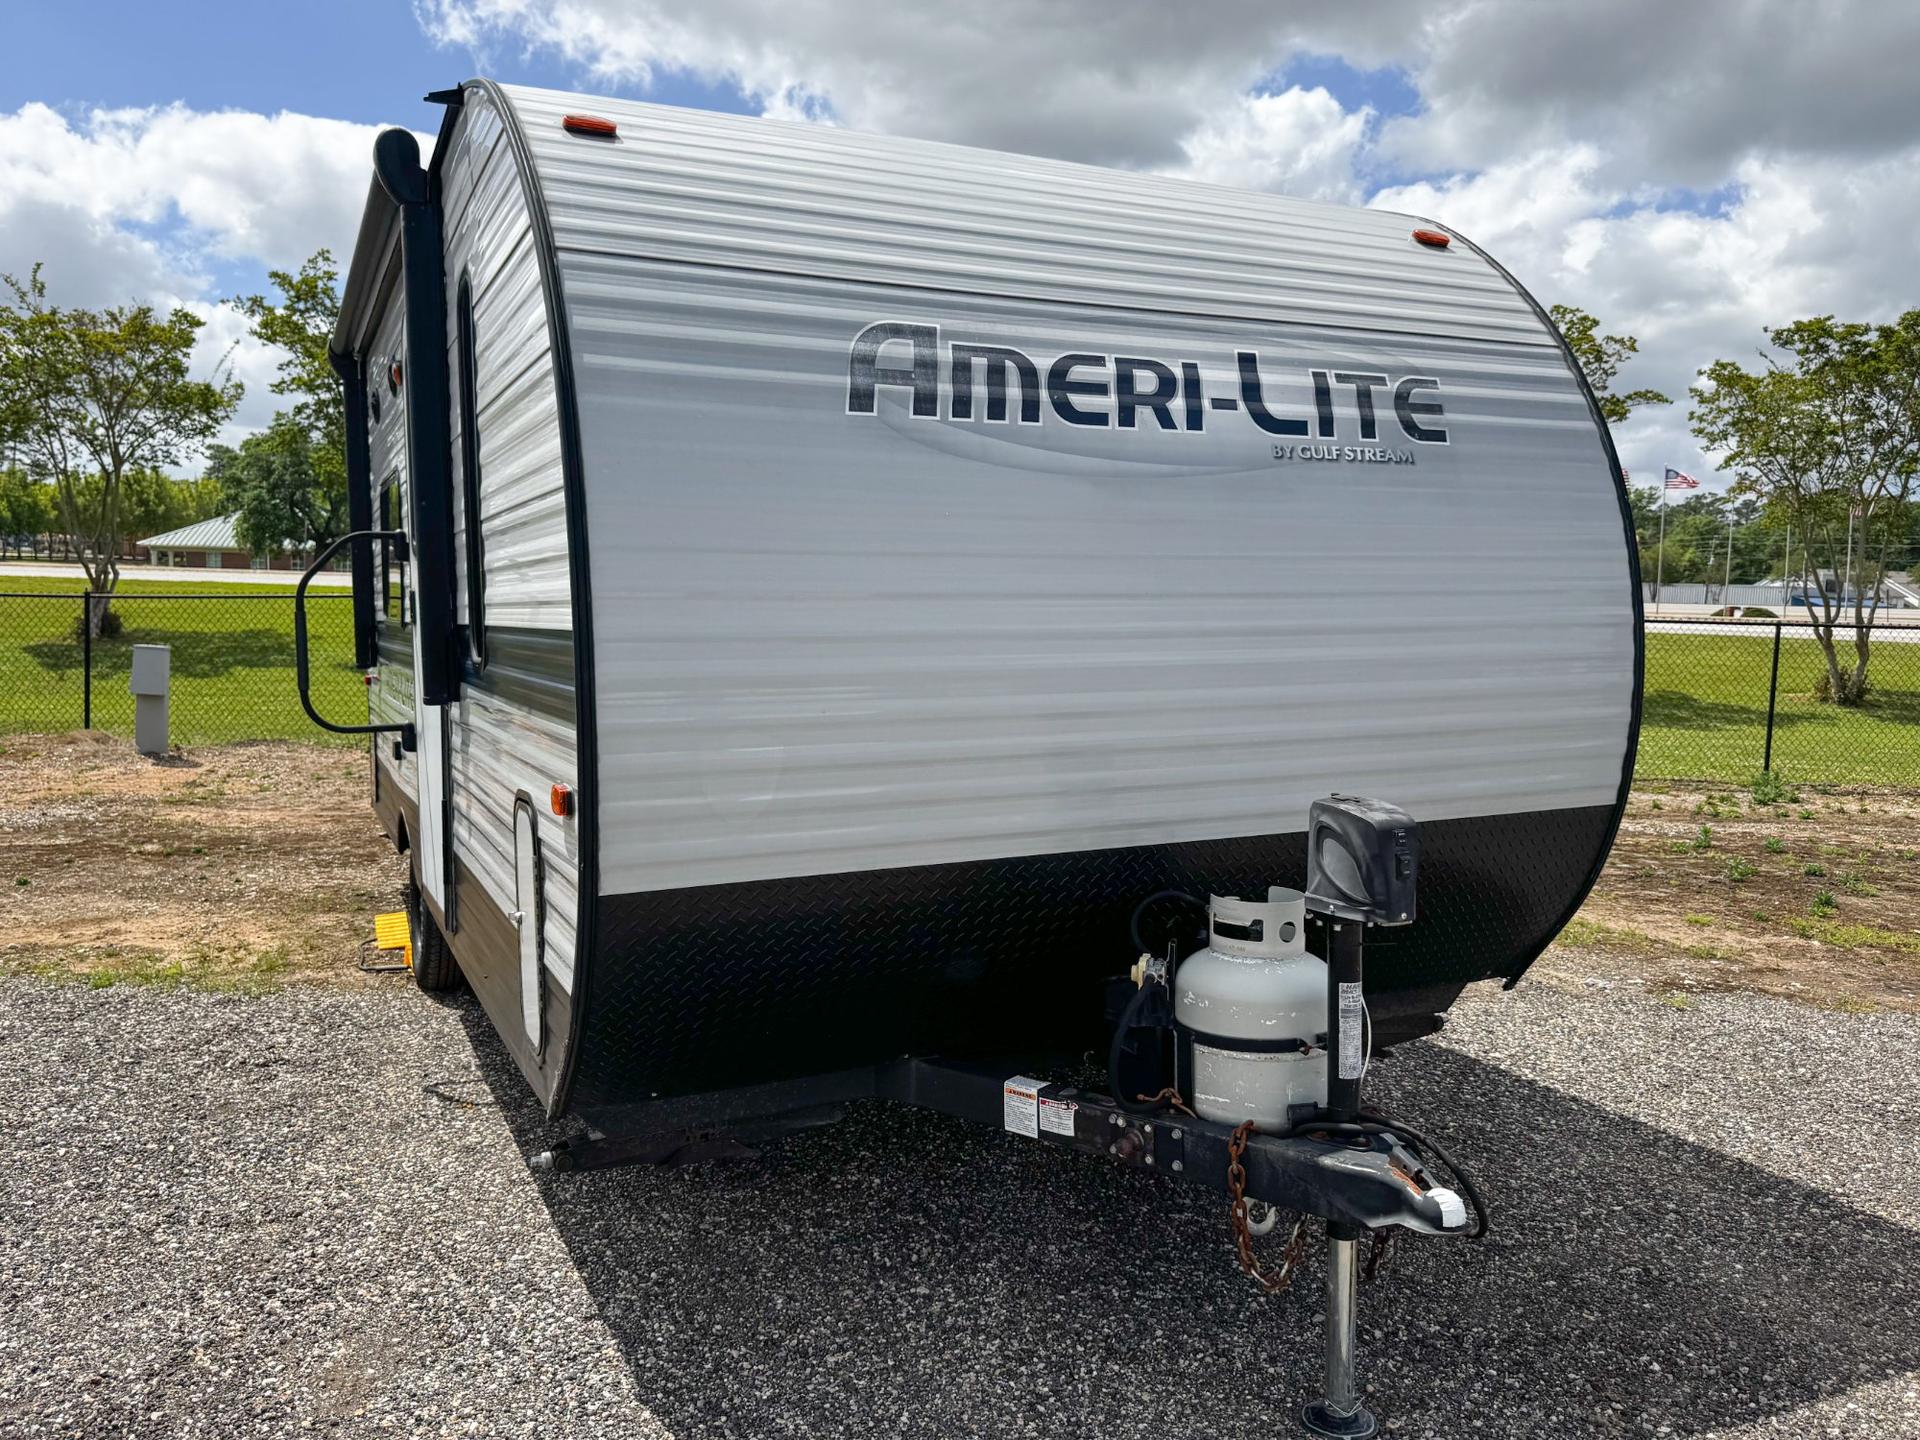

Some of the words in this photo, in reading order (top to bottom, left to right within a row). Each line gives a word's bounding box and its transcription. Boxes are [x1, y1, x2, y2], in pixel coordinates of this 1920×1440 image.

[1273, 445, 1293, 459] BY
[1297, 445, 1341, 461] GULF
[1344, 446, 1415, 464] STREAM
